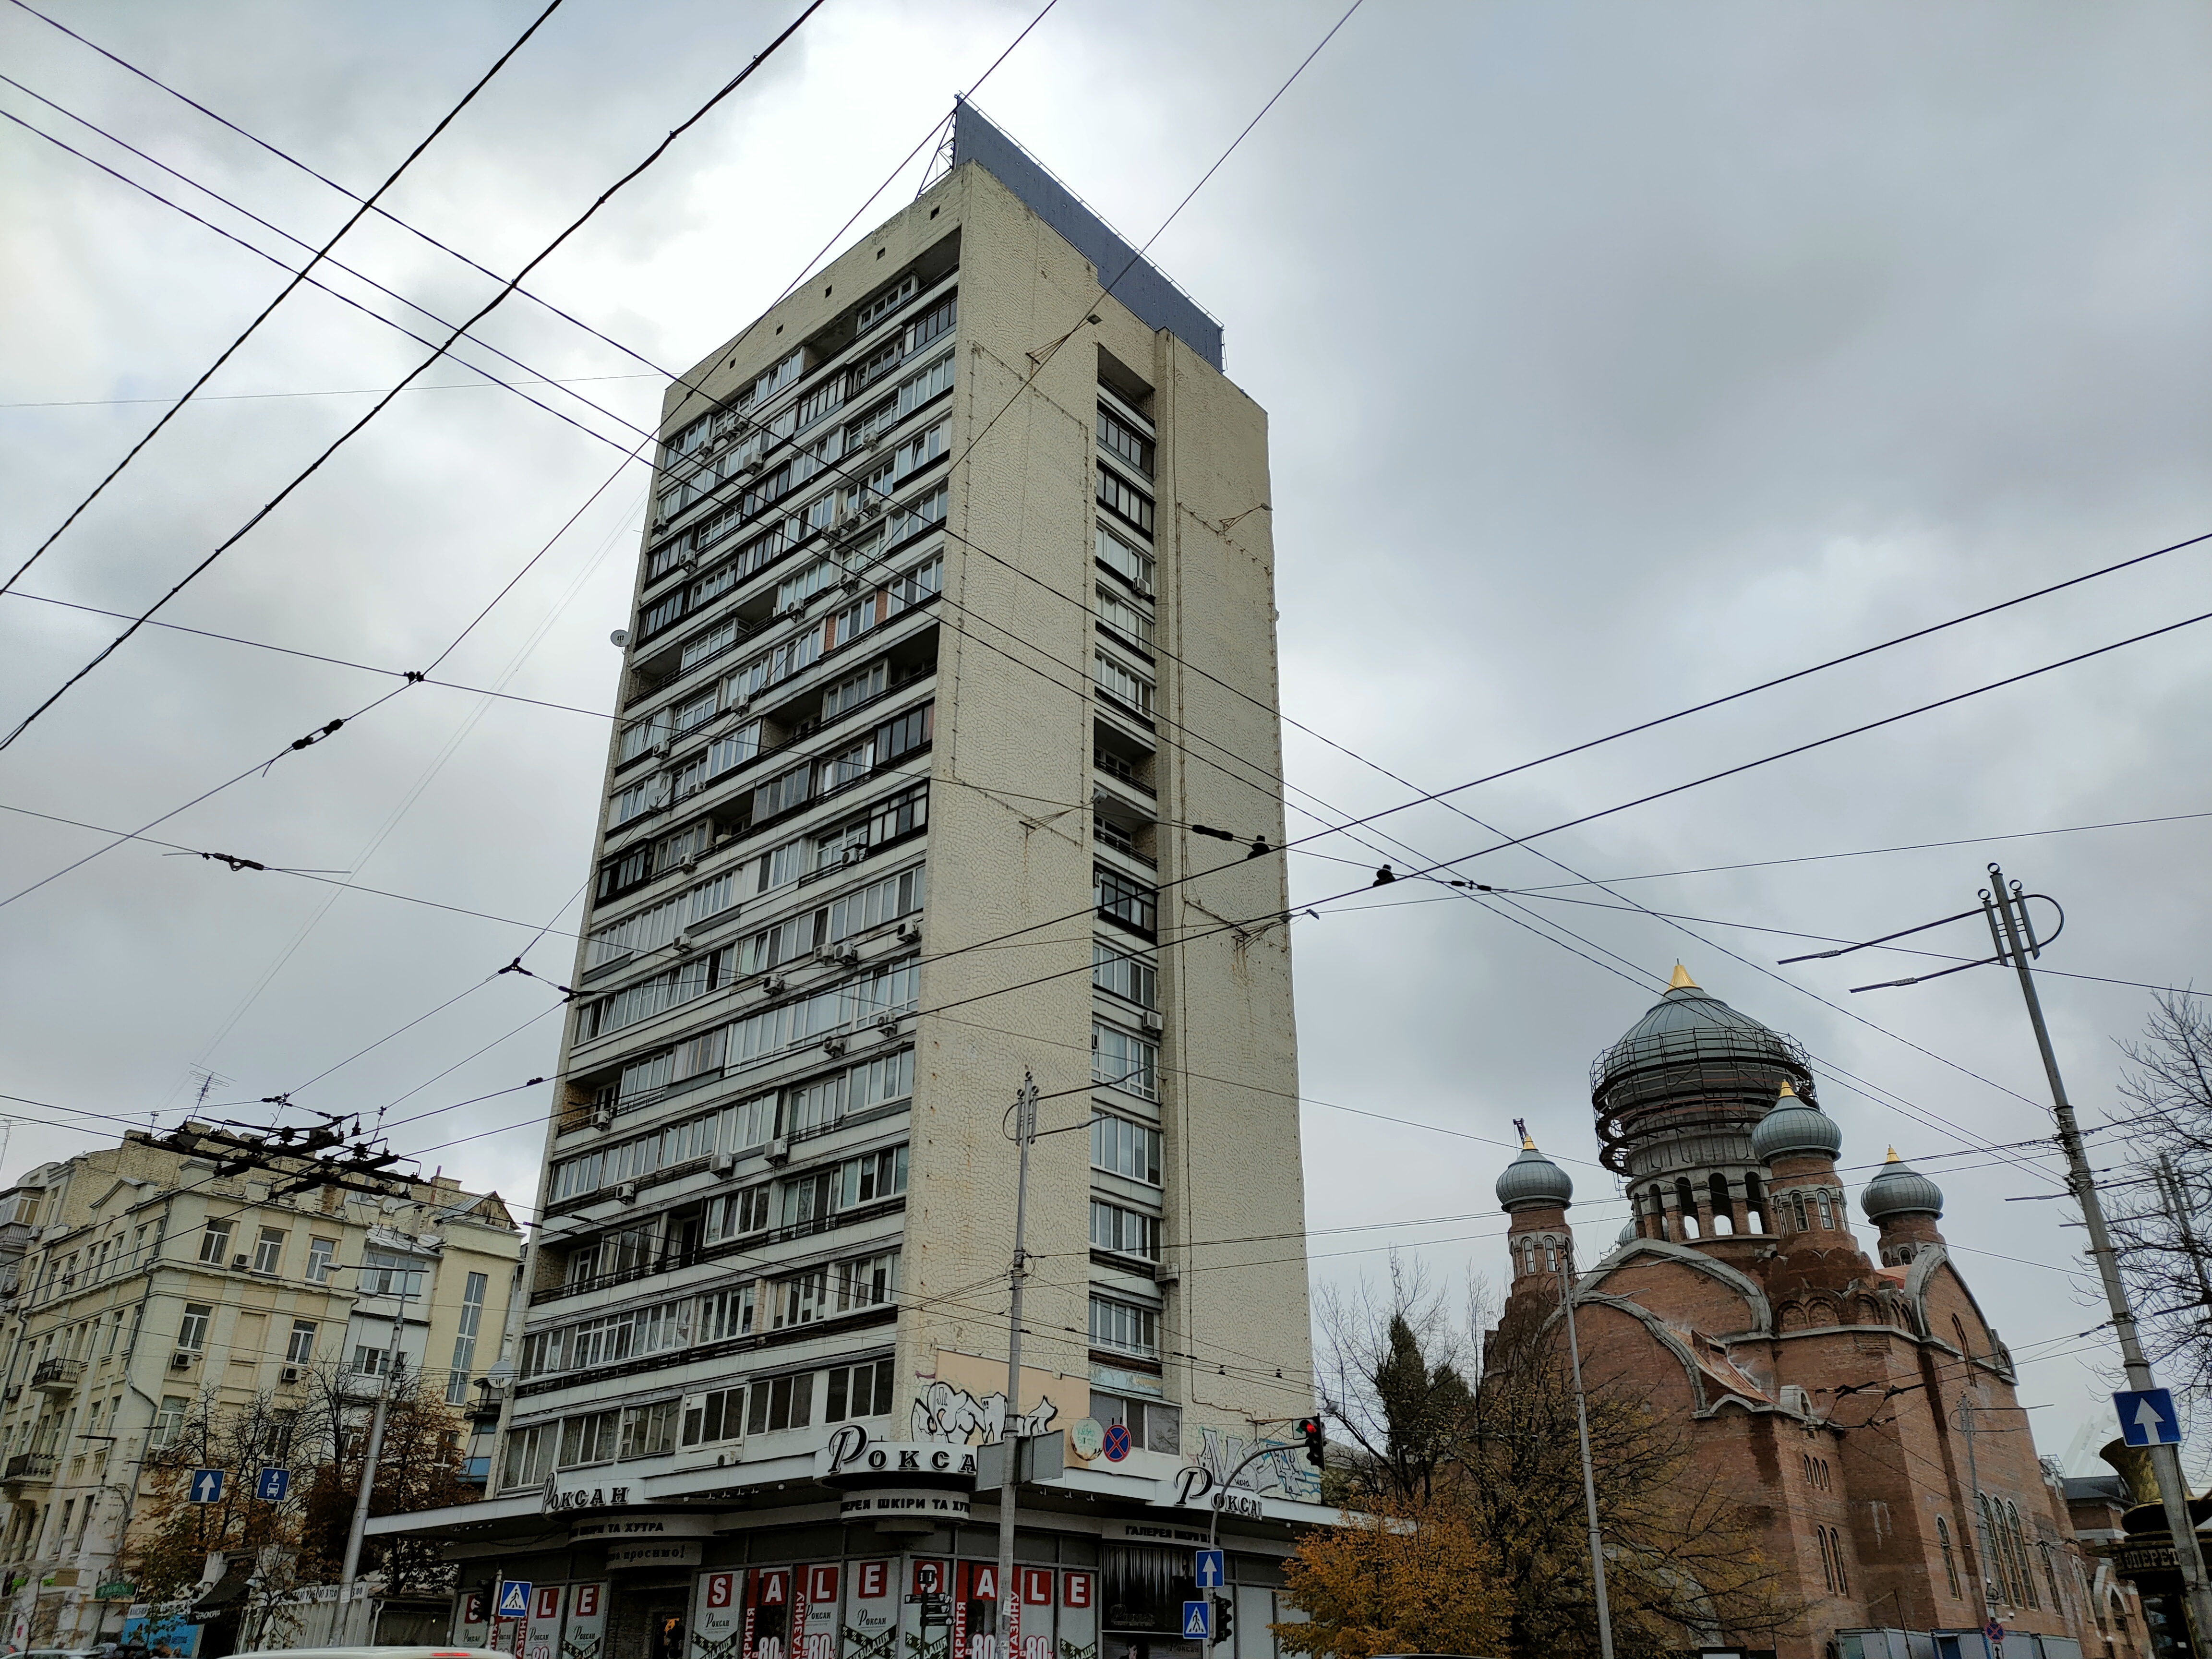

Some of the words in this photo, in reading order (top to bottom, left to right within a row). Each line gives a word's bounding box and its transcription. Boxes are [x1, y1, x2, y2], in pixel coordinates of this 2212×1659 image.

[828, 1424, 977, 1473] РОКСА
[878, 1498, 926, 1509] ШКІРИ
[932, 1499, 948, 1510] ТА
[607, 1523, 620, 1533] ТА
[625, 1522, 664, 1532] ХУТРА
[1126, 1525, 1172, 1538] ГАЛЕРЕЯ
[2124, 1547, 2180, 1569] ОПЕРЕТ
